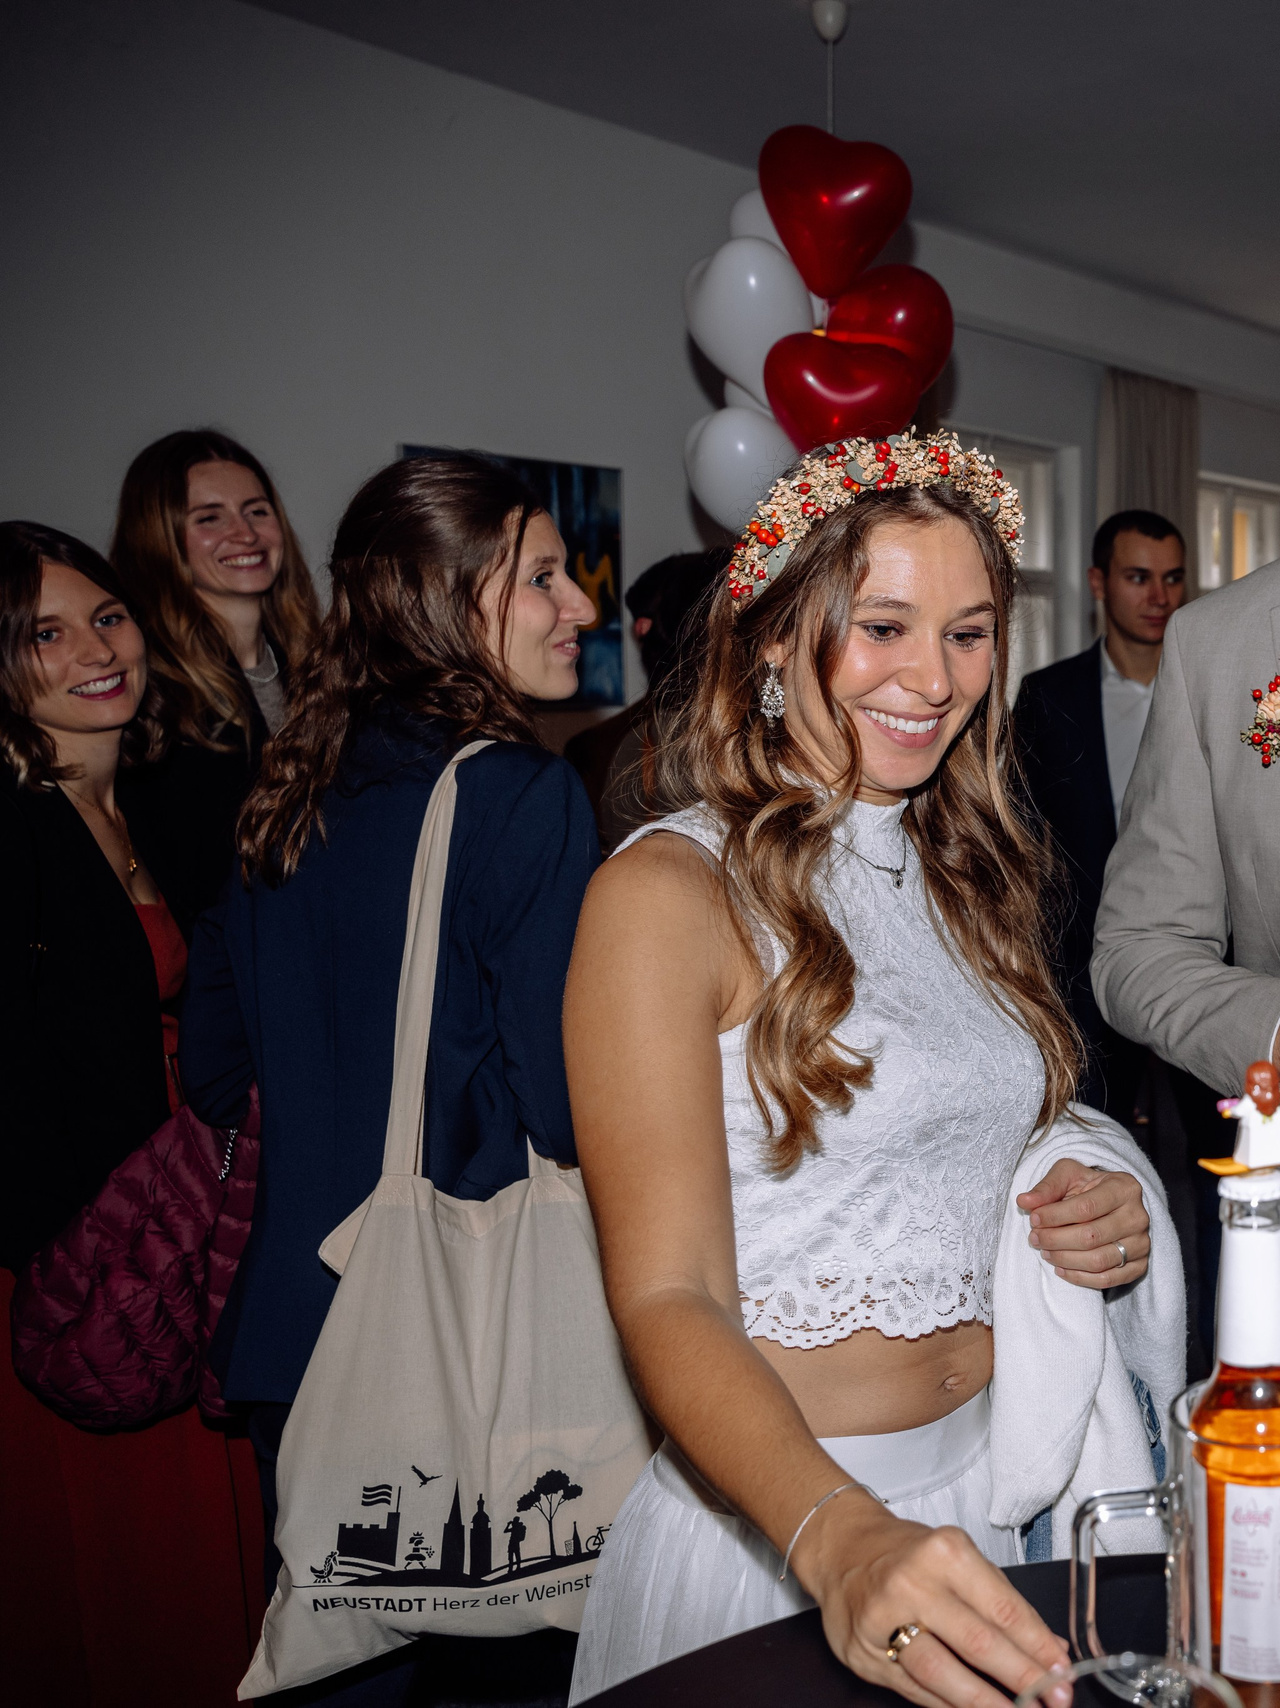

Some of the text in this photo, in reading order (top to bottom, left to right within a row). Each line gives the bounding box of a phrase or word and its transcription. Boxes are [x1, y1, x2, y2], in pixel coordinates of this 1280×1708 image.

[312, 1597, 427, 1613] NEUSTADT
[434, 1597, 481, 1611] Herz
[486, 1593, 520, 1607] der
